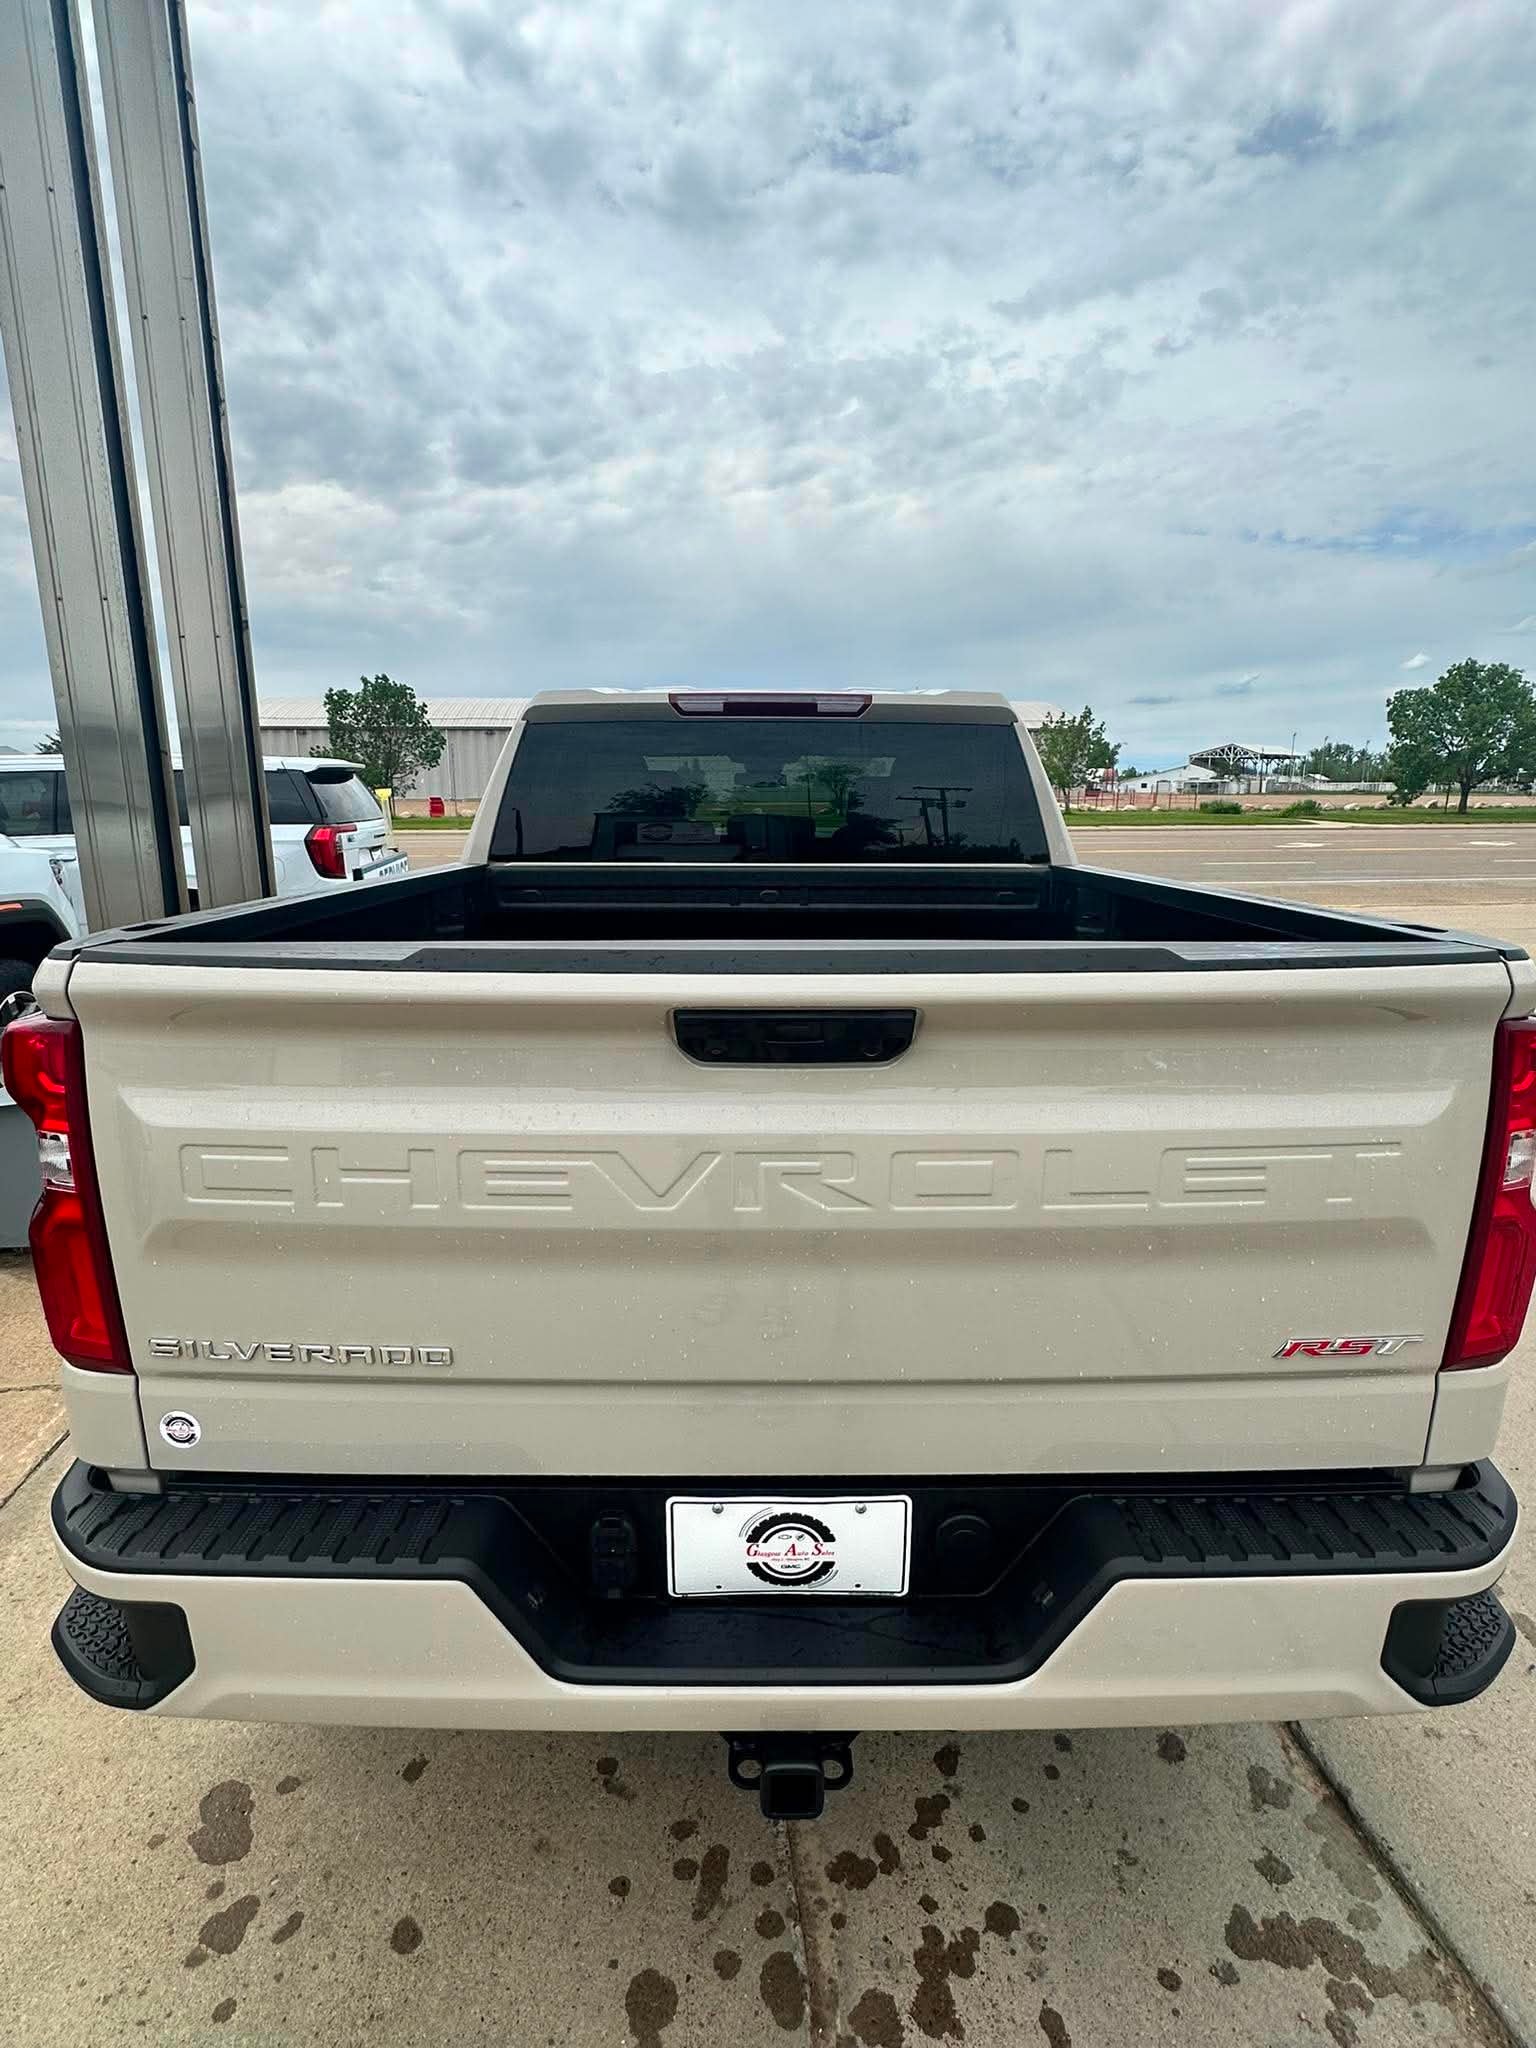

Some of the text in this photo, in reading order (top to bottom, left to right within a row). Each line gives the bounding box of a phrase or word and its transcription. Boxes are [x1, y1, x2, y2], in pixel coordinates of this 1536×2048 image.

[179, 1142, 1403, 1212] CHEVROLET
[148, 1338, 453, 1366] SILVERADO
[1272, 1335, 1424, 1359] RST
[784, 1543, 809, 1556] Auto
[811, 1542, 835, 1556] Sales
